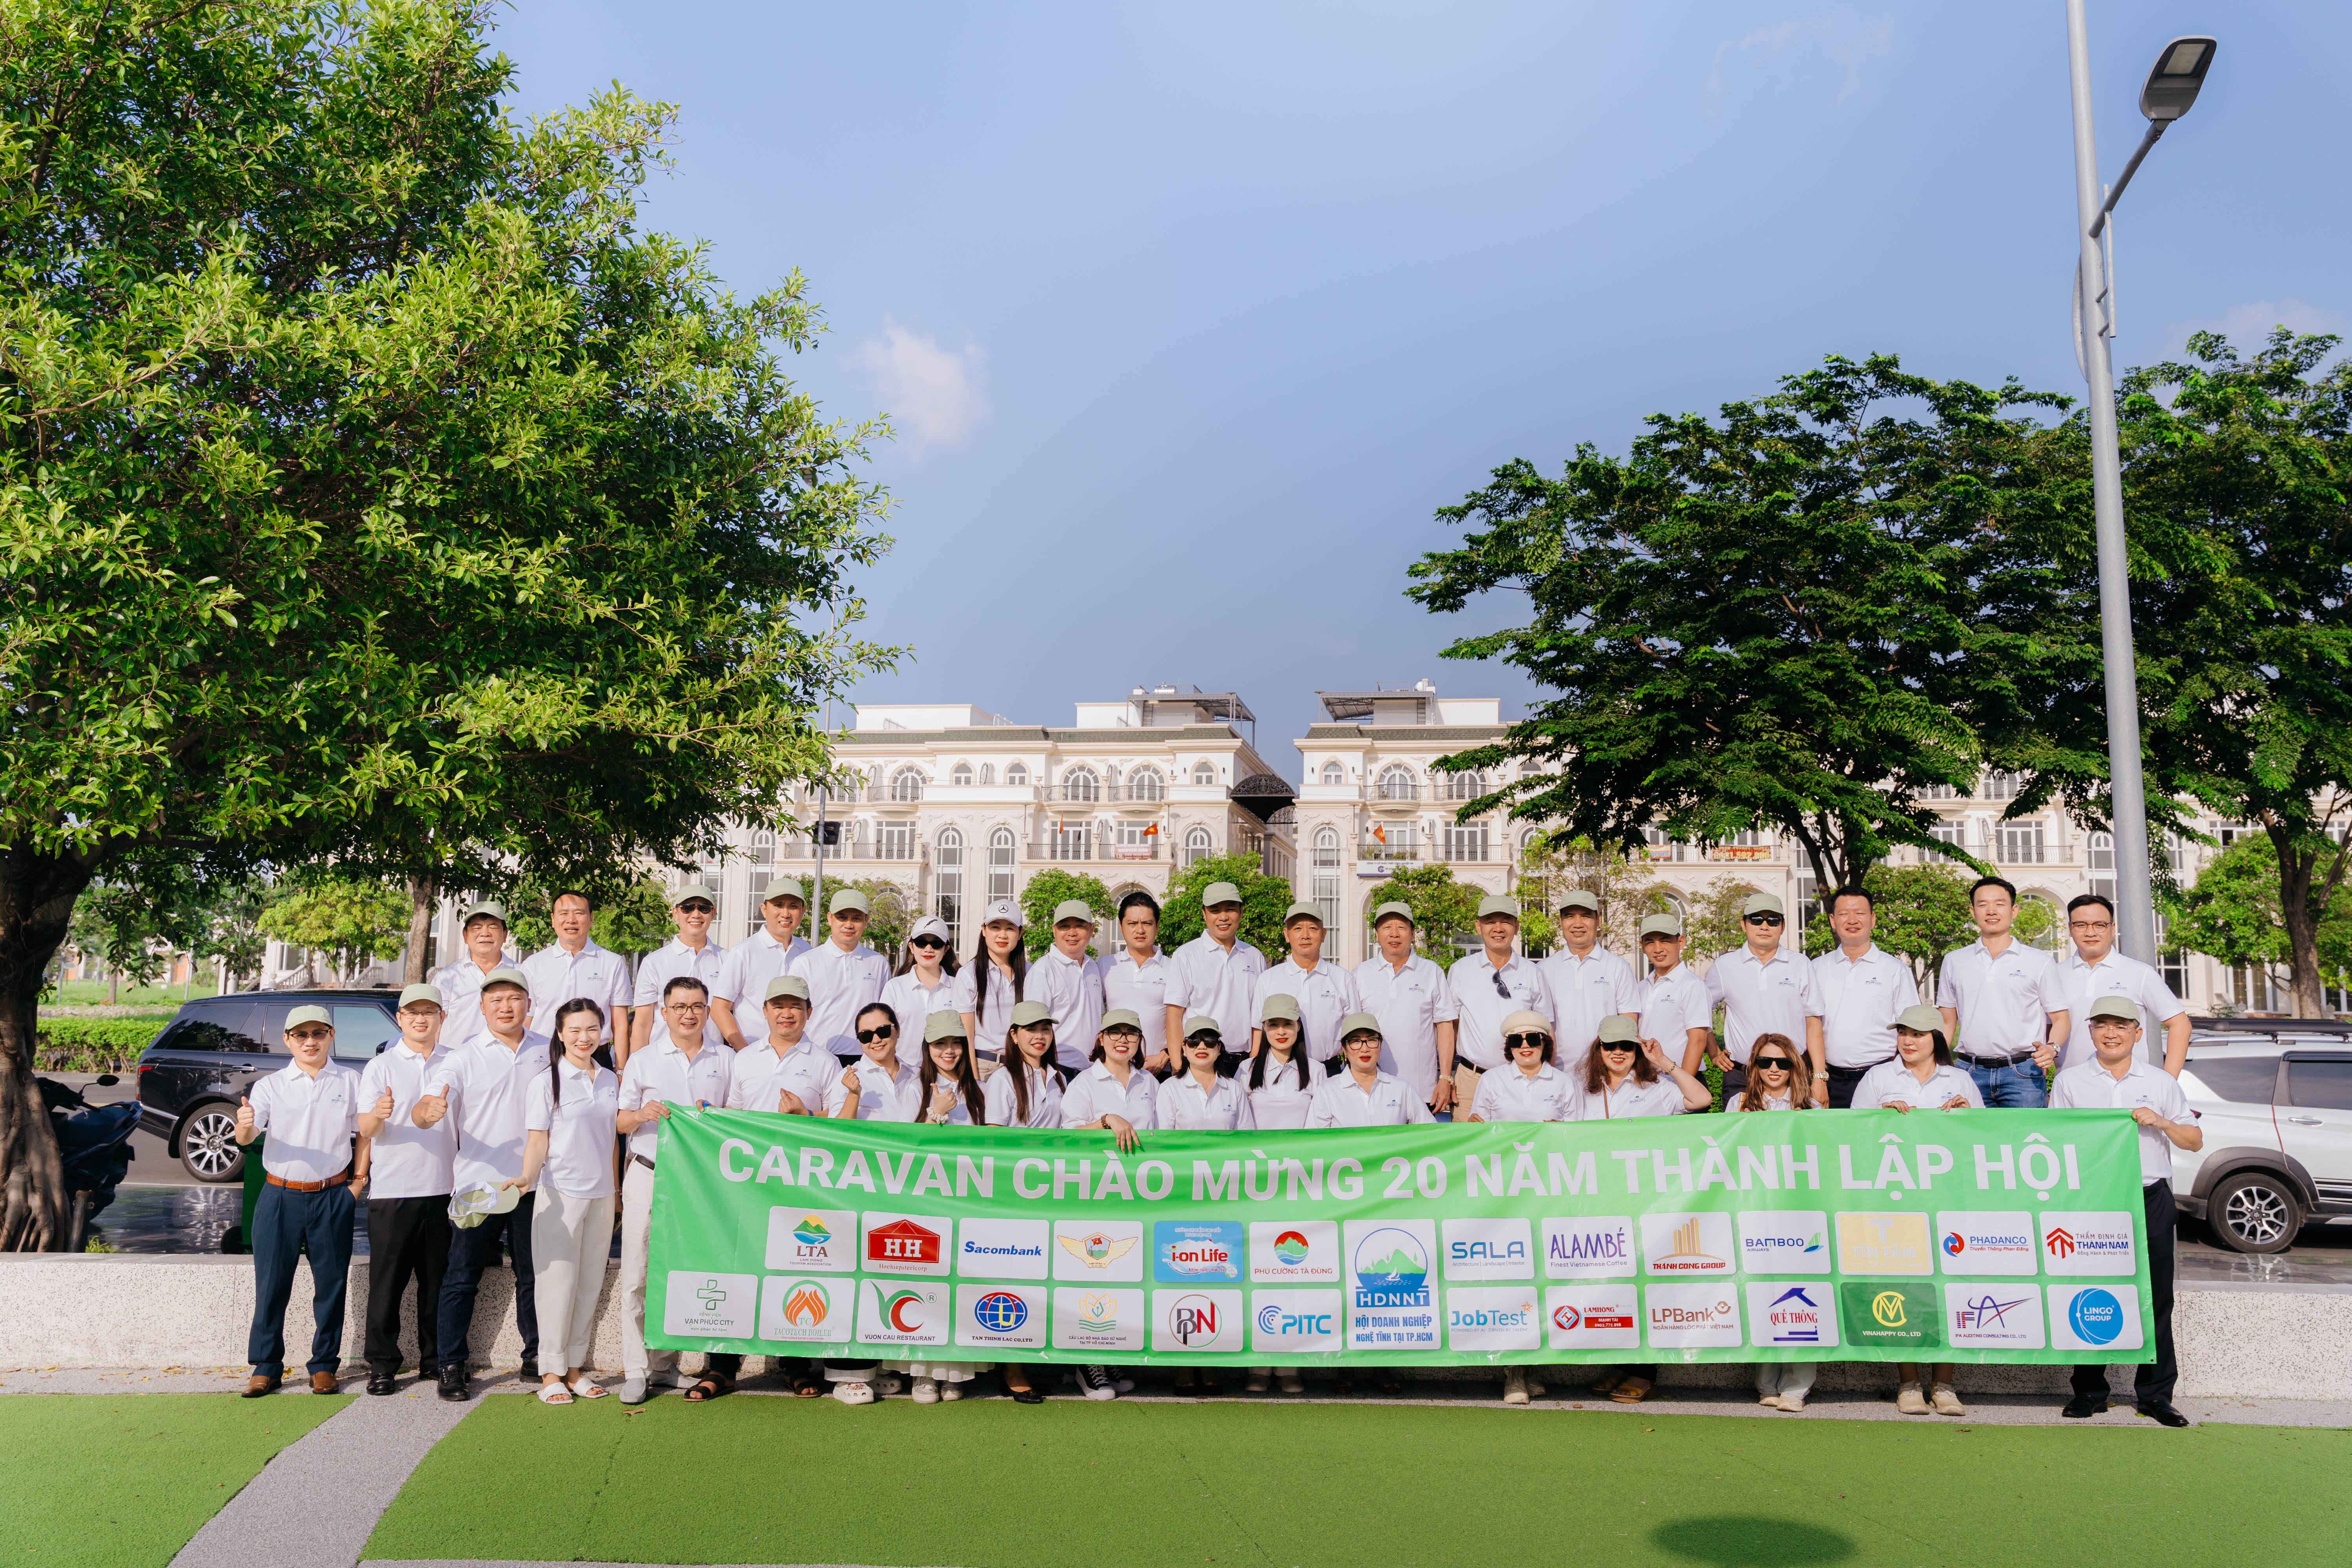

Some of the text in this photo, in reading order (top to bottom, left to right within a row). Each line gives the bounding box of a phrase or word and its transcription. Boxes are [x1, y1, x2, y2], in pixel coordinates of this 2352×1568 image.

[719, 1132, 2081, 1201] CARAVAN CHÀO MỪNG 20 NĂM THÀNH LẬP HỘI
[1746, 1238, 1804, 1247] BAMBOO
[2075, 1231, 2095, 1239] THẨM
[884, 1238, 922, 1258] HH
[964, 1241, 1042, 1256] Sacombank
[1452, 1241, 1524, 1259] SALA
[1550, 1227, 1626, 1259] ALAMBÉ
[1851, 1243, 1916, 1258] TÍN TÂM
[2076, 1240, 2107, 1249] THÀNH
[796, 1246, 828, 1257] LTA
[1171, 1245, 1228, 1262] i-on Life
[1360, 1292, 1427, 1306] HDNNT
[1356, 1314, 1432, 1330] HỘI DOANH NGHIỆP
[1451, 1310, 1528, 1326] JobTest
[1653, 1308, 1715, 1323] LPBank
[1789, 1309, 1817, 1323] THÔNG
[1282, 1315, 1331, 1334] PITC
[1356, 1331, 1433, 1343] NGHỆ TĨNH TẠI TP.HCM
